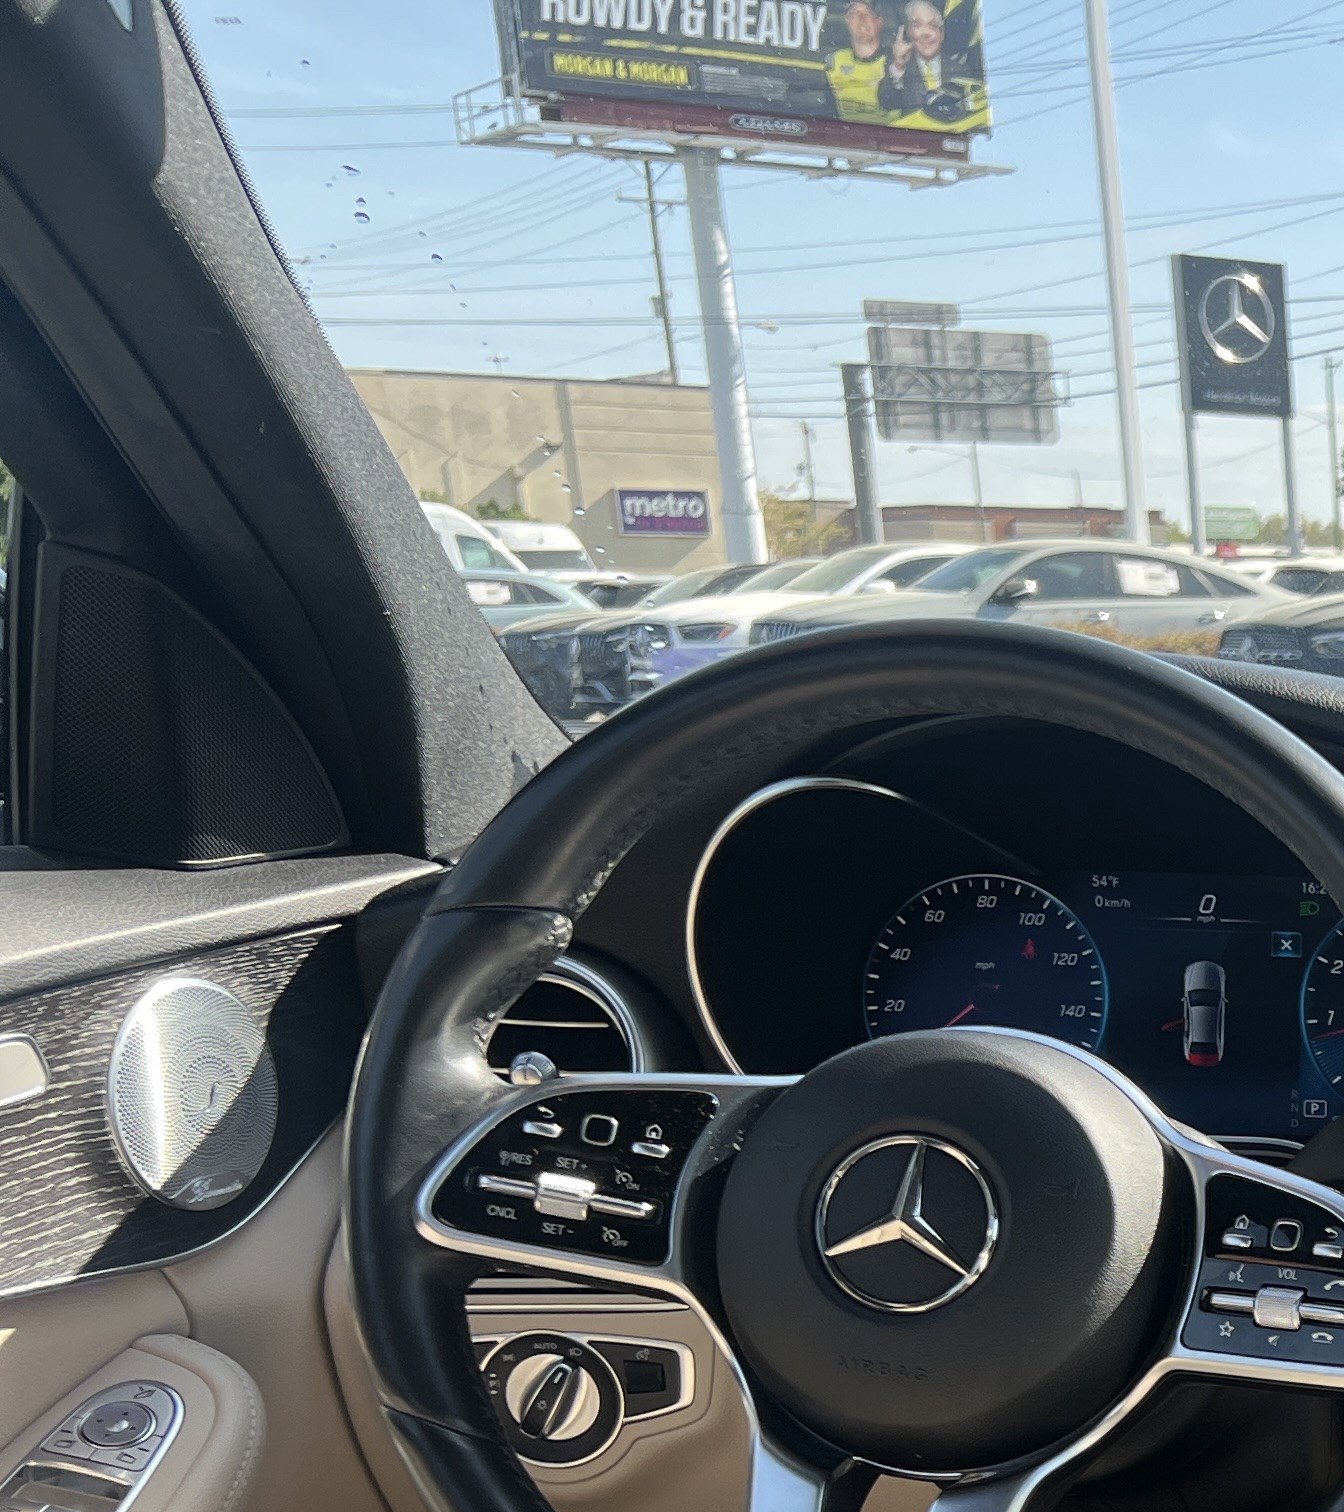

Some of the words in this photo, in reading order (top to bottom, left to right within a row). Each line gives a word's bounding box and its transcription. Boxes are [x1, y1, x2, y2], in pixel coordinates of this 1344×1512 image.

[680, 0, 706, 39] &
[712, 0, 827, 50] READY
[623, 493, 704, 522] metro
[1302, 882, 1327, 895] 16:2
[976, 896, 998, 908] 80
[1105, 898, 1131, 909] km/h
[1199, 894, 1217, 914] 0
[924, 910, 945, 923] 60
[1019, 912, 1046, 926] 100
[890, 948, 911, 961] 40
[1052, 952, 1078, 966] 120
[975, 962, 995, 970] mph
[1331, 960, 1344, 975] 2
[884, 1000, 905, 1012] 20
[1060, 1004, 1086, 1018] 140
[1327, 1010, 1335, 1025] 1
[1310, 1104, 1319, 1115] P
[556, 1156, 579, 1169] SET
[486, 1204, 517, 1220] CNCL
[541, 1222, 566, 1235] SET
[1278, 1268, 1297, 1281] VOL
[534, 1342, 557, 1350] AUTO
